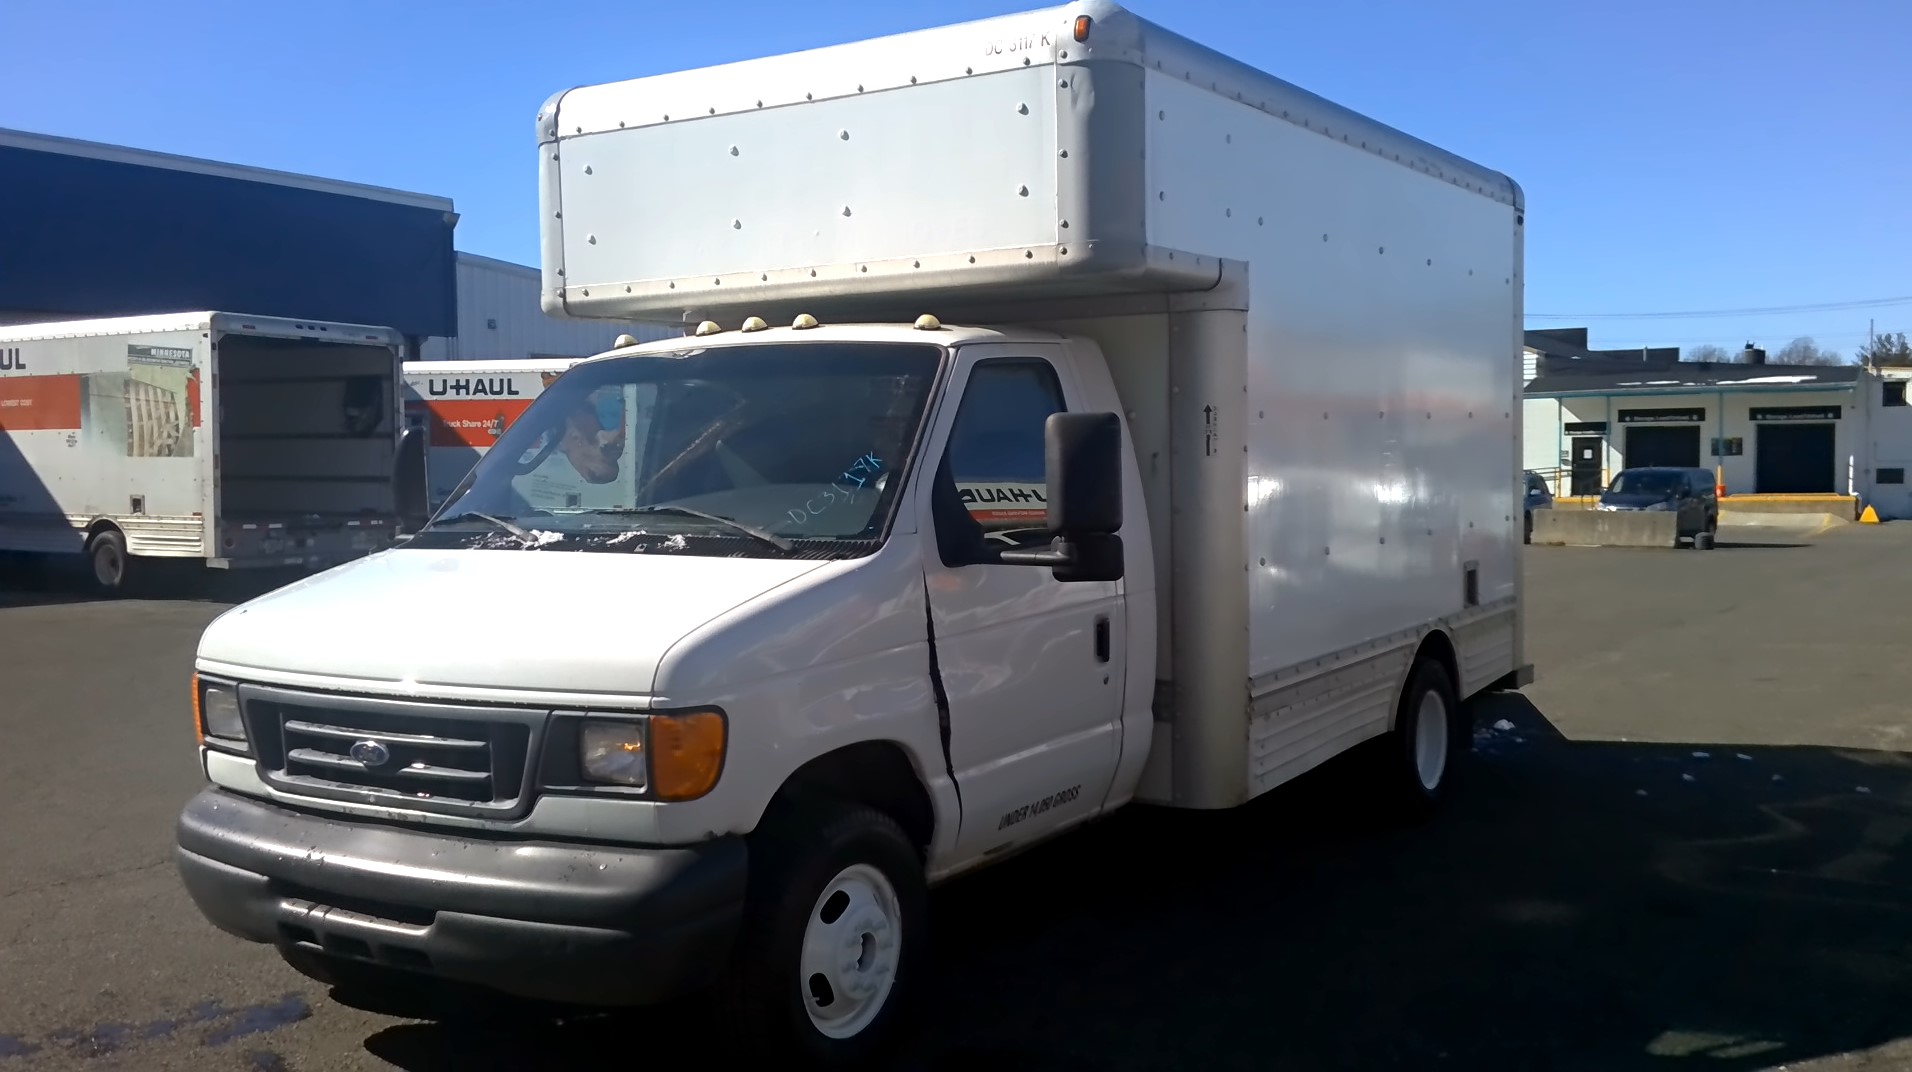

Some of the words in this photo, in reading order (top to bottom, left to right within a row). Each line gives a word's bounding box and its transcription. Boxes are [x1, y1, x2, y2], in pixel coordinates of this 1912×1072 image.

[151, 348, 190, 358] MINNESOTA
[428, 378, 520, 396] U-HAUL
[462, 419, 482, 428] Share
